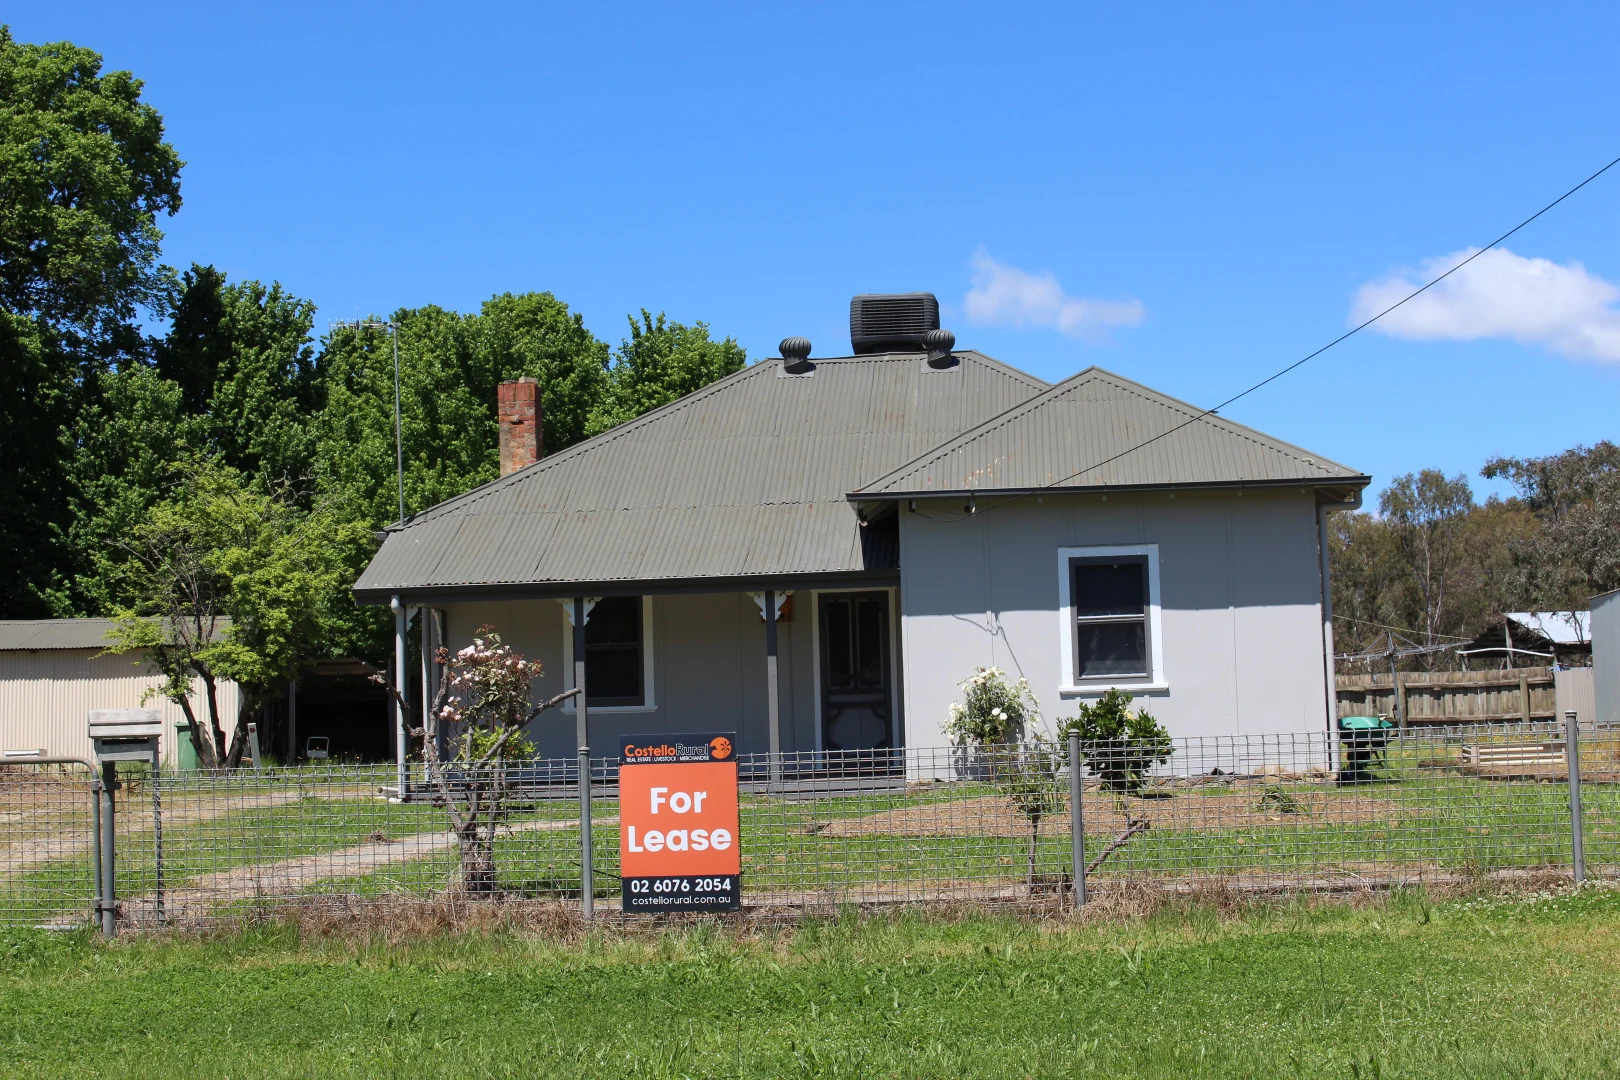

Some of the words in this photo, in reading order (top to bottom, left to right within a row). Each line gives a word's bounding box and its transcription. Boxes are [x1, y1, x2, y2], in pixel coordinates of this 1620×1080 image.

[650, 787, 707, 814] For
[627, 826, 732, 853] Lease
[631, 879, 649, 893] 02
[653, 879, 690, 893] 6076
[694, 878, 731, 892] 2054
[632, 895, 731, 905] costellorural.com.au
